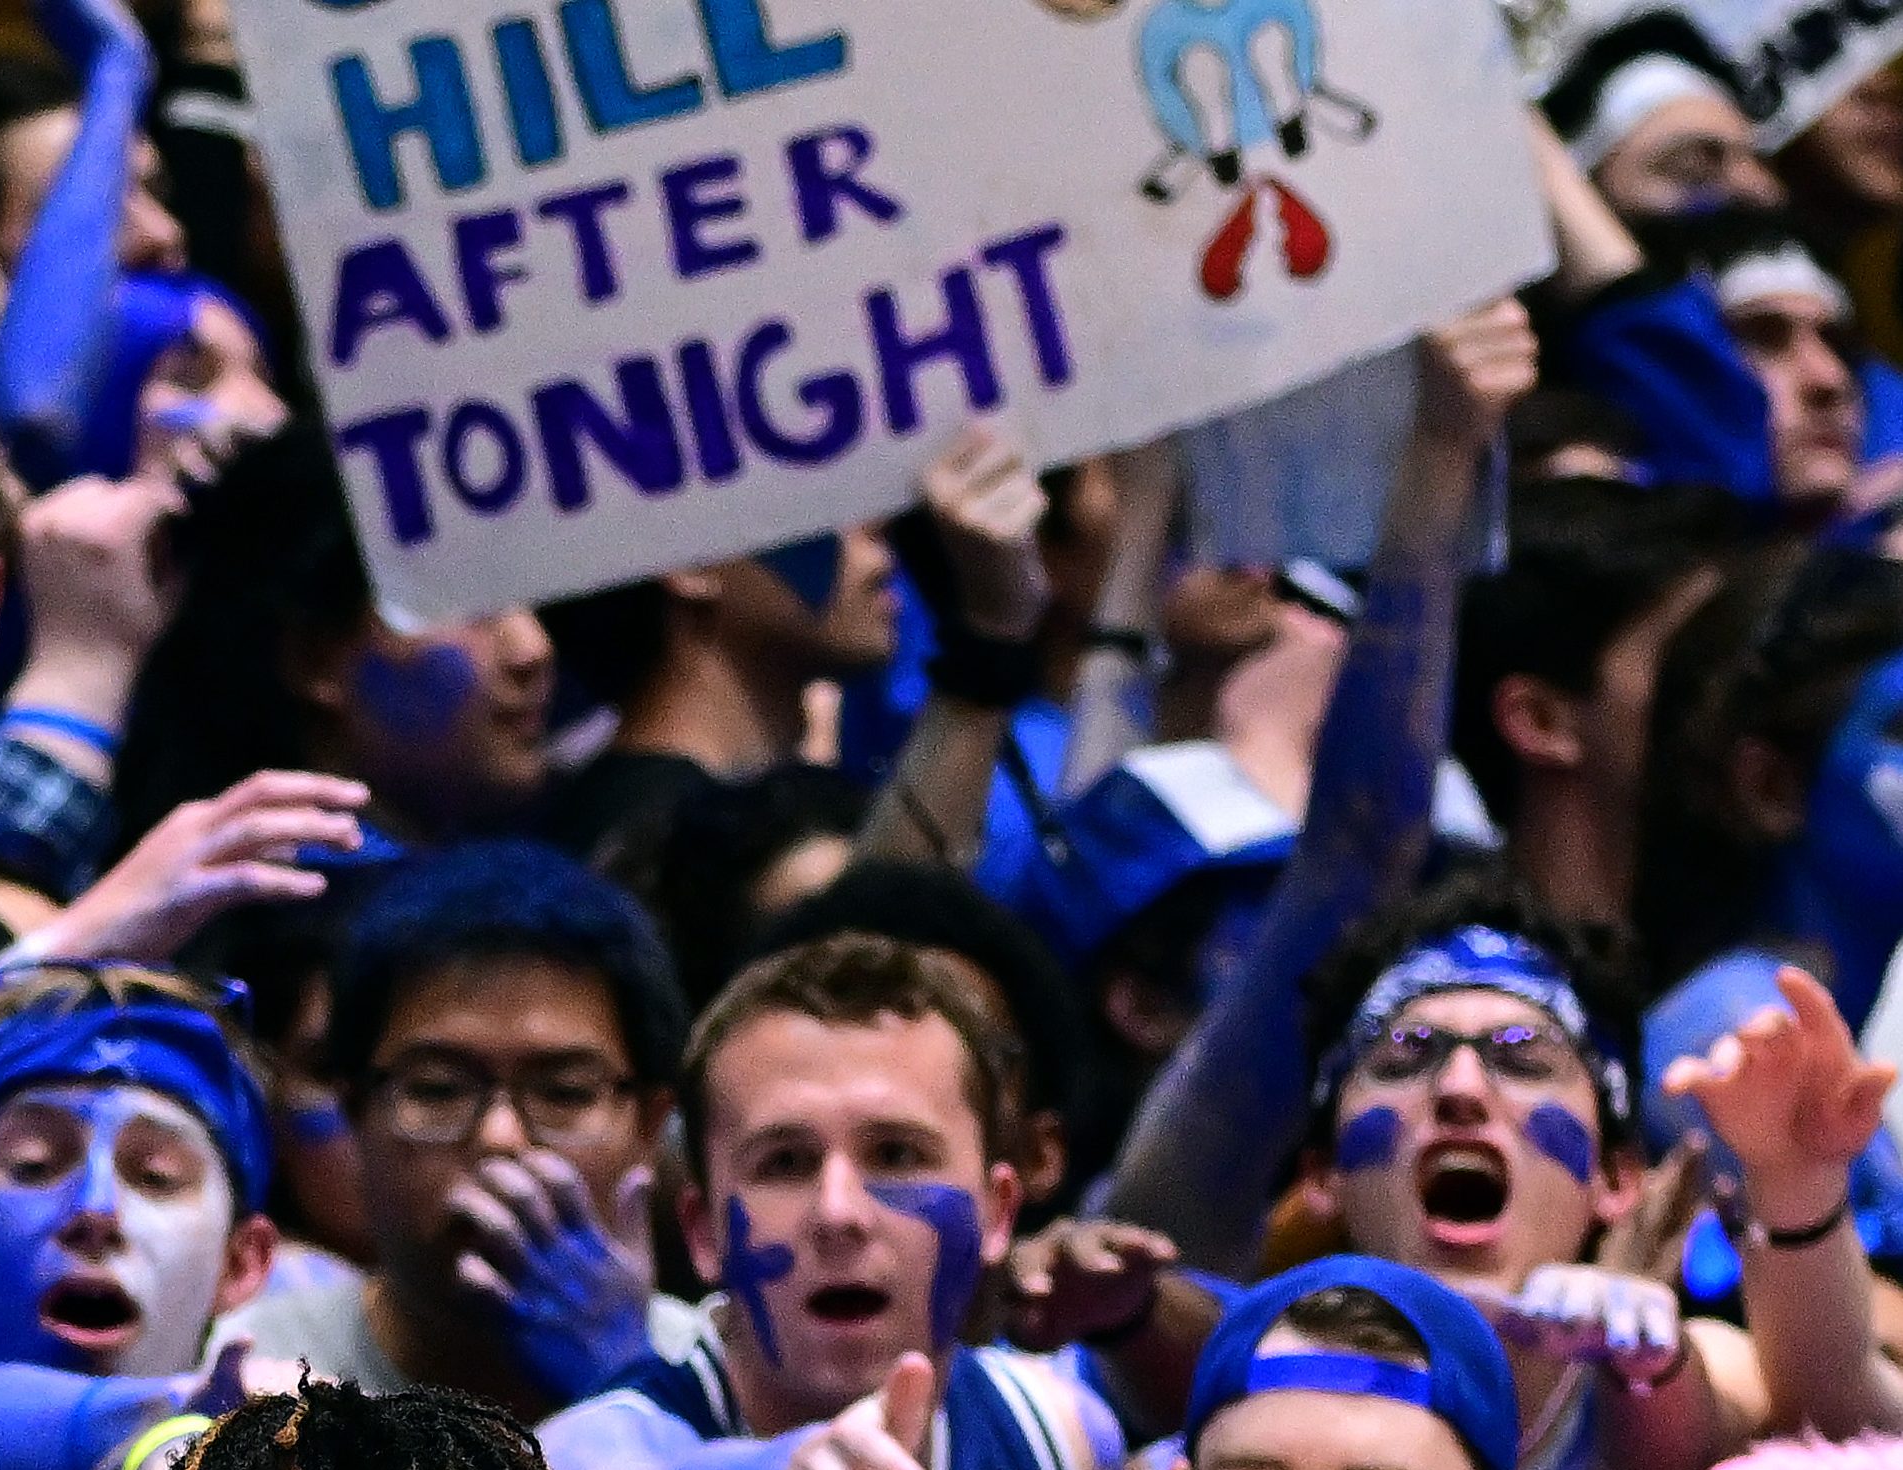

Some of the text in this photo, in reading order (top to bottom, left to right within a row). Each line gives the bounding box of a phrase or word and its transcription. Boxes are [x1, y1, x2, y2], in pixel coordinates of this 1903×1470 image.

[329, 0, 849, 209] HILL
[326, 125, 905, 366] AFTER
[338, 224, 1074, 545] TONIGHT
